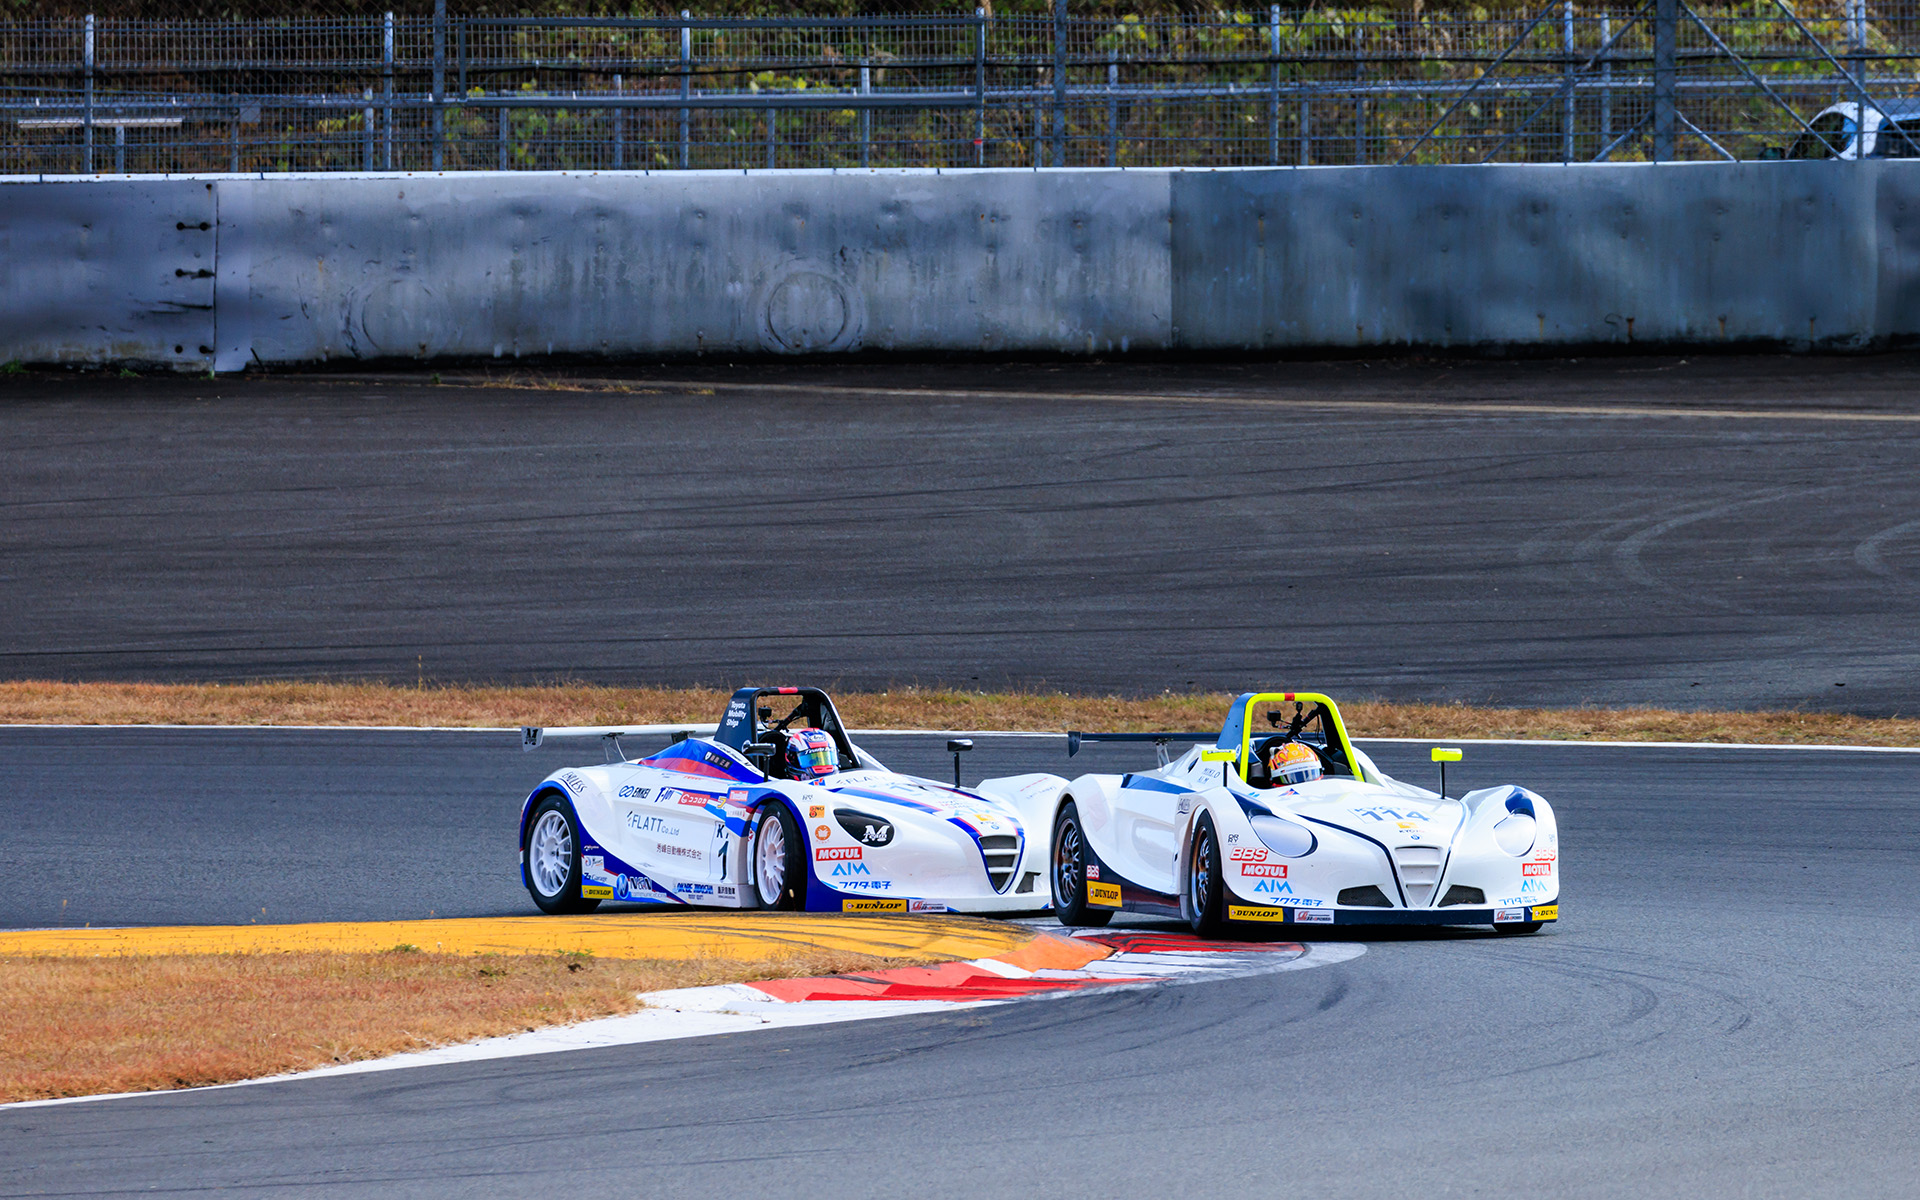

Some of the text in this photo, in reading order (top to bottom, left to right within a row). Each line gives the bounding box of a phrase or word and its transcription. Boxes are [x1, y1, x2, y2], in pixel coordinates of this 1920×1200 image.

[732, 701, 746, 710] Toyota
[728, 710, 746, 720] Mobility
[726, 718, 739, 728] Shiga
[1361, 810, 1430, 822] 114
[632, 814, 664, 832] FLATT
[718, 840, 729, 880] 1
[818, 848, 860, 860] MOTUL
[1230, 846, 1268, 862] BBS
[1534, 848, 1556, 861] BBS
[832, 862, 870, 876] AIM
[1243, 864, 1286, 876] MOTUL
[1524, 864, 1550, 876] MOTUL
[839, 881, 892, 889] フクダ電子
[1254, 879, 1293, 894] AIM
[1094, 888, 1118, 900] DUNLOP
[1270, 897, 1323, 906] フクダ電子
